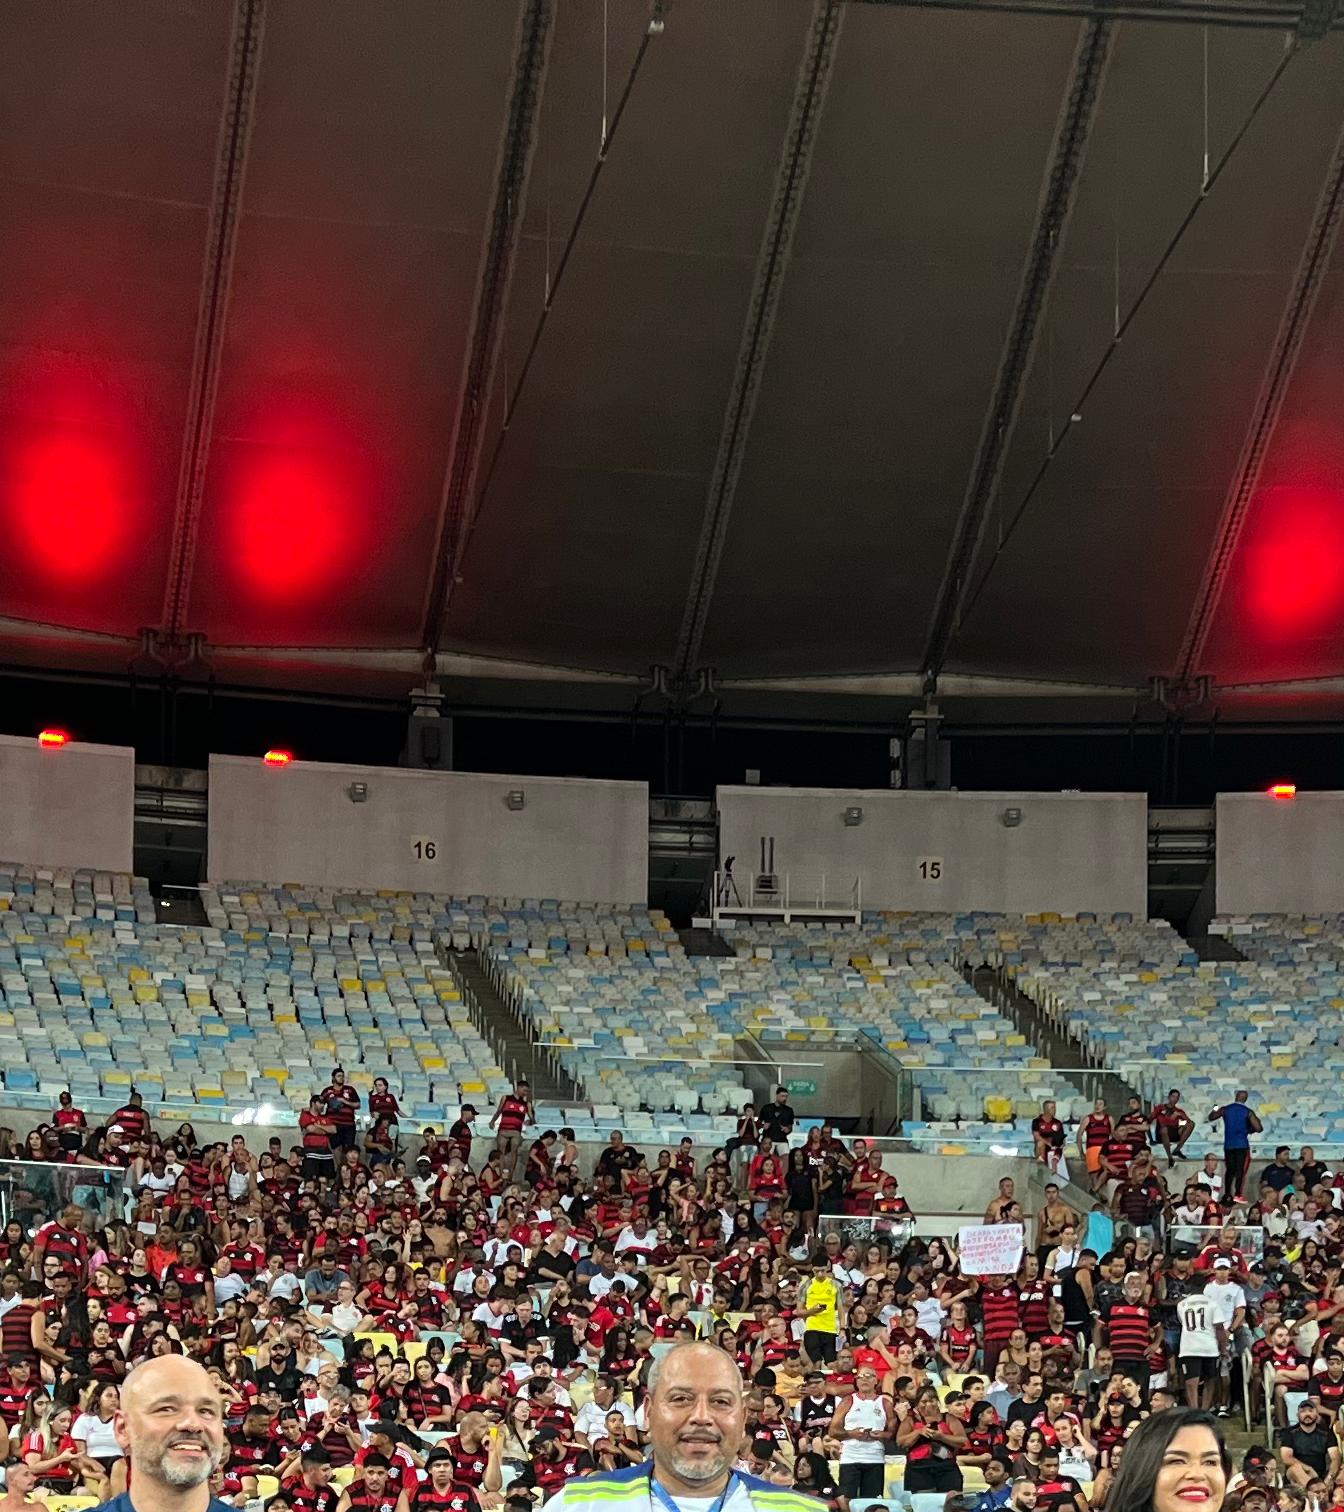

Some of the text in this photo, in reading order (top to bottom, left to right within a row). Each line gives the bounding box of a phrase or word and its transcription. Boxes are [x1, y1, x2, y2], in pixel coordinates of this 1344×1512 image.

[413, 840, 437, 860] 16
[919, 861, 941, 880] 15
[1184, 1306, 1207, 1332] 01
